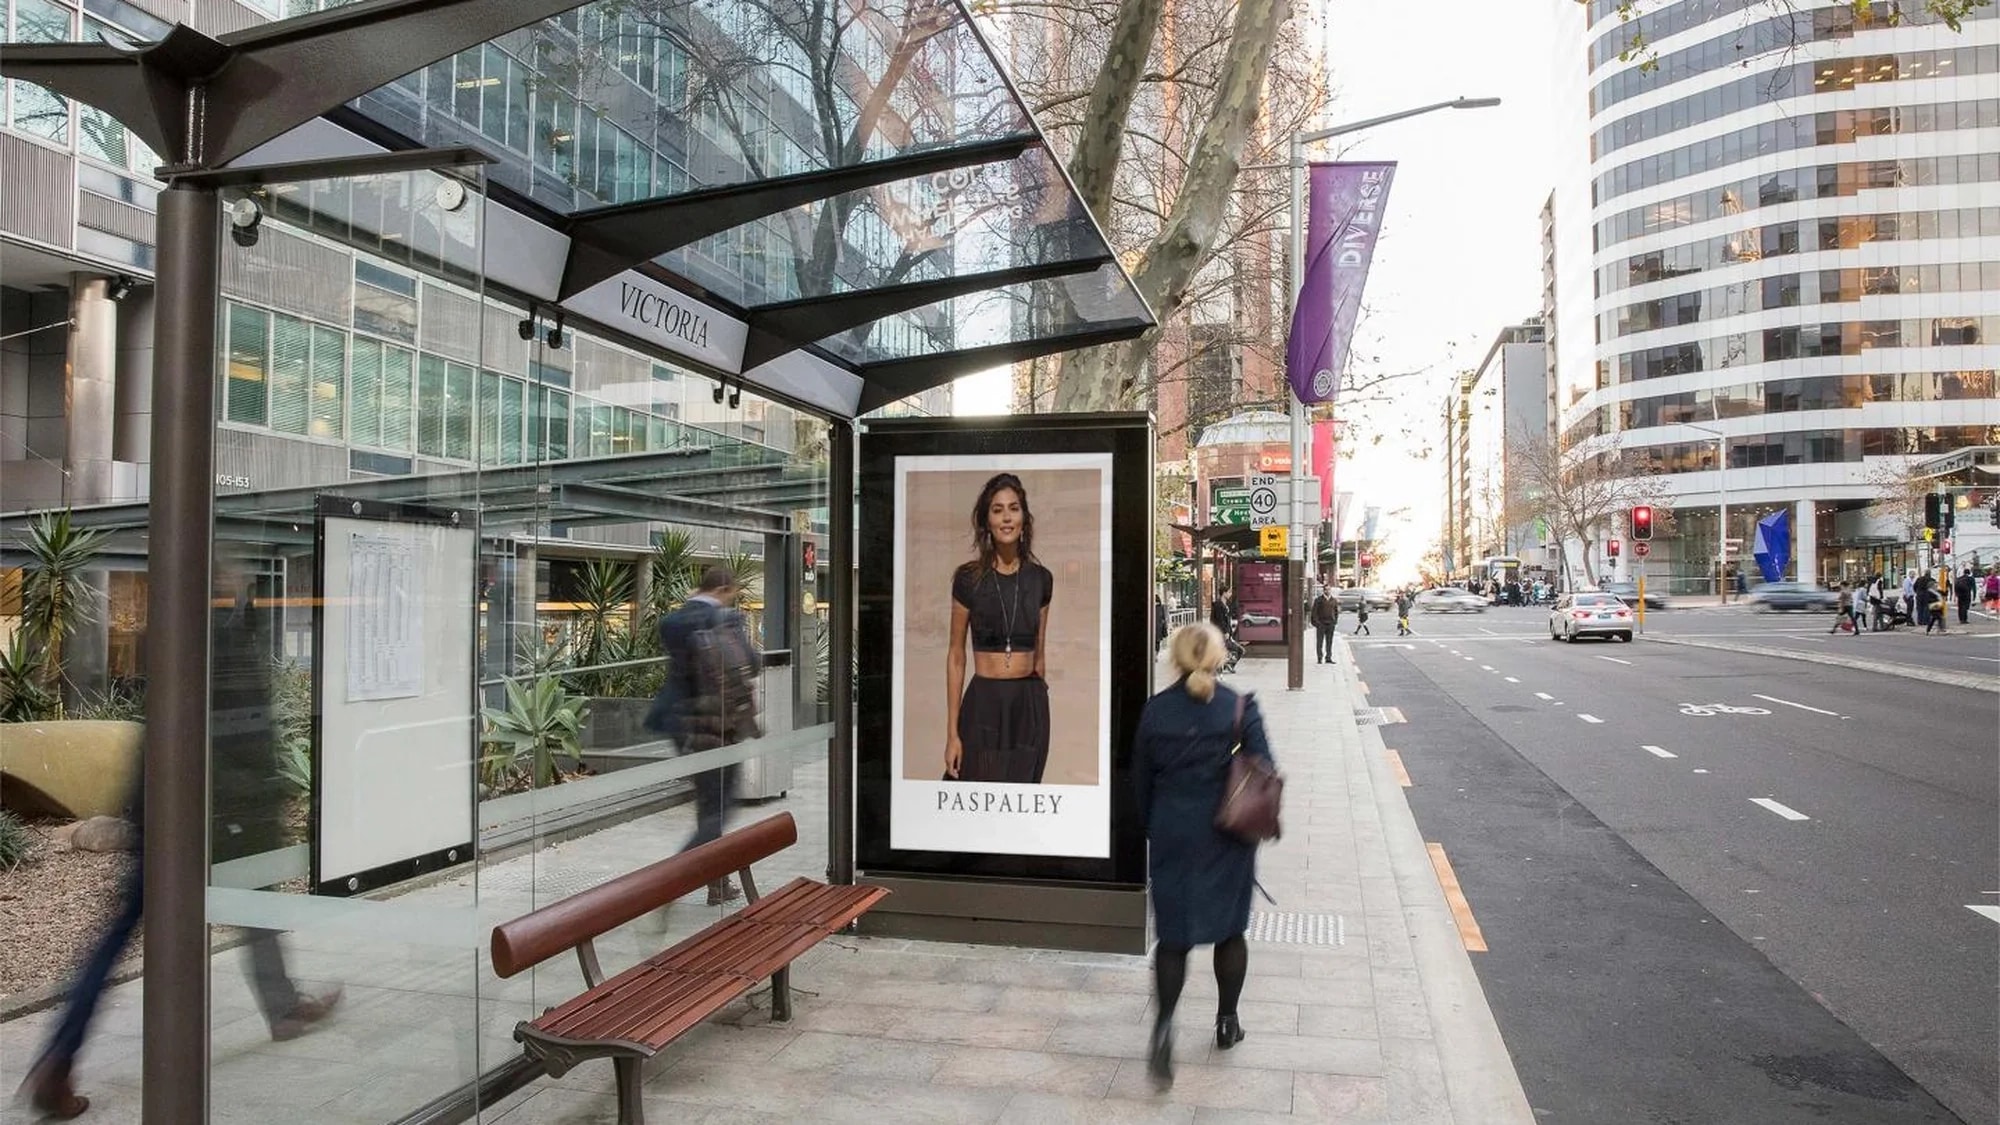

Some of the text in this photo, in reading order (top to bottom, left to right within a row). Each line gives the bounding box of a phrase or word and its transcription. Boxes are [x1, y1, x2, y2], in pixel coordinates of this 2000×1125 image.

[1338, 171, 1384, 268] DIVERSE
[621, 281, 708, 348] VICTORIA
[216, 473, 250, 488] 105-153
[1252, 477, 1275, 486] END
[1254, 494, 1274, 507] 40
[1252, 516, 1277, 525] AREA
[937, 791, 1062, 814] PASPALEY
